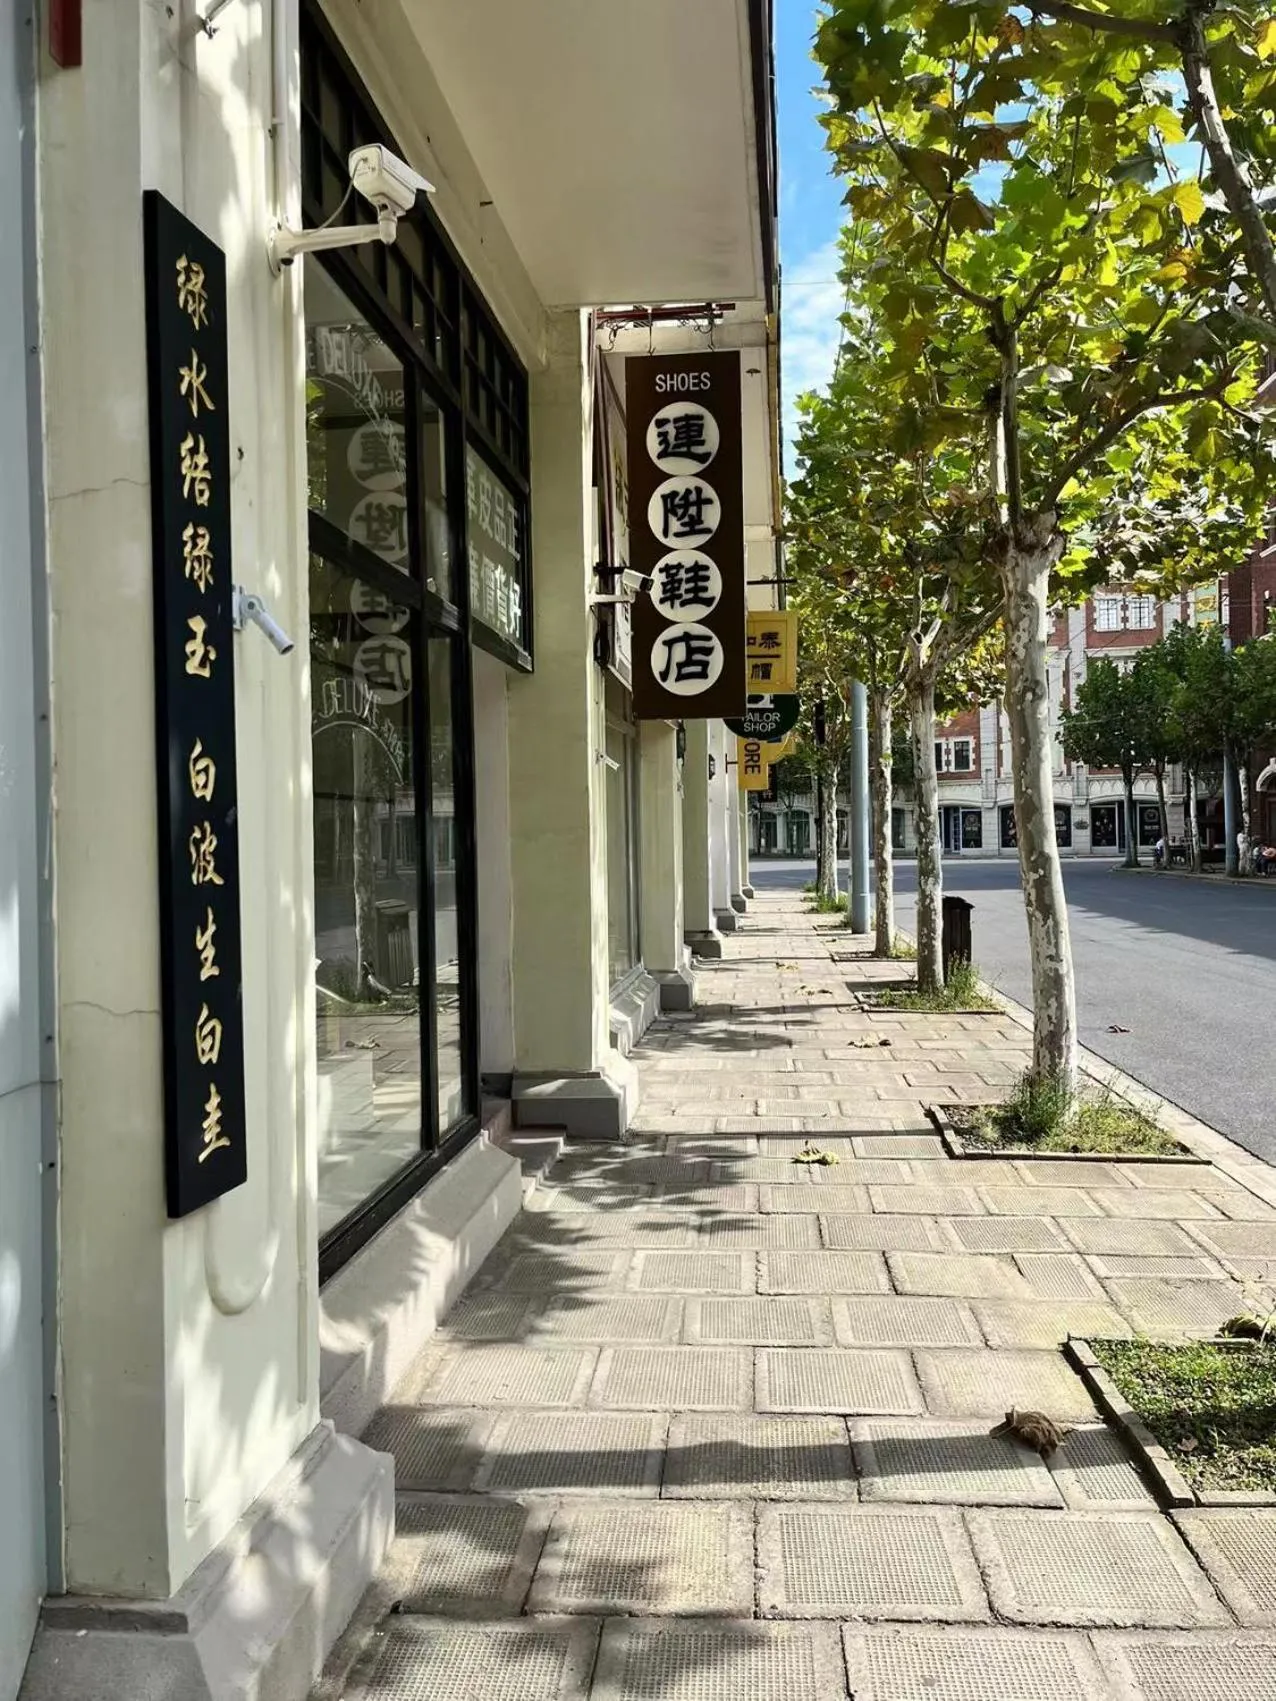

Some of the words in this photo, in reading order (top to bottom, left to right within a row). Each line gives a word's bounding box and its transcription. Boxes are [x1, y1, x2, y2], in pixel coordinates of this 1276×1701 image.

[655, 372, 711, 393] SHOES
[655, 413, 716, 683] 連陞鞋店
[743, 722, 776, 733] SHOP
